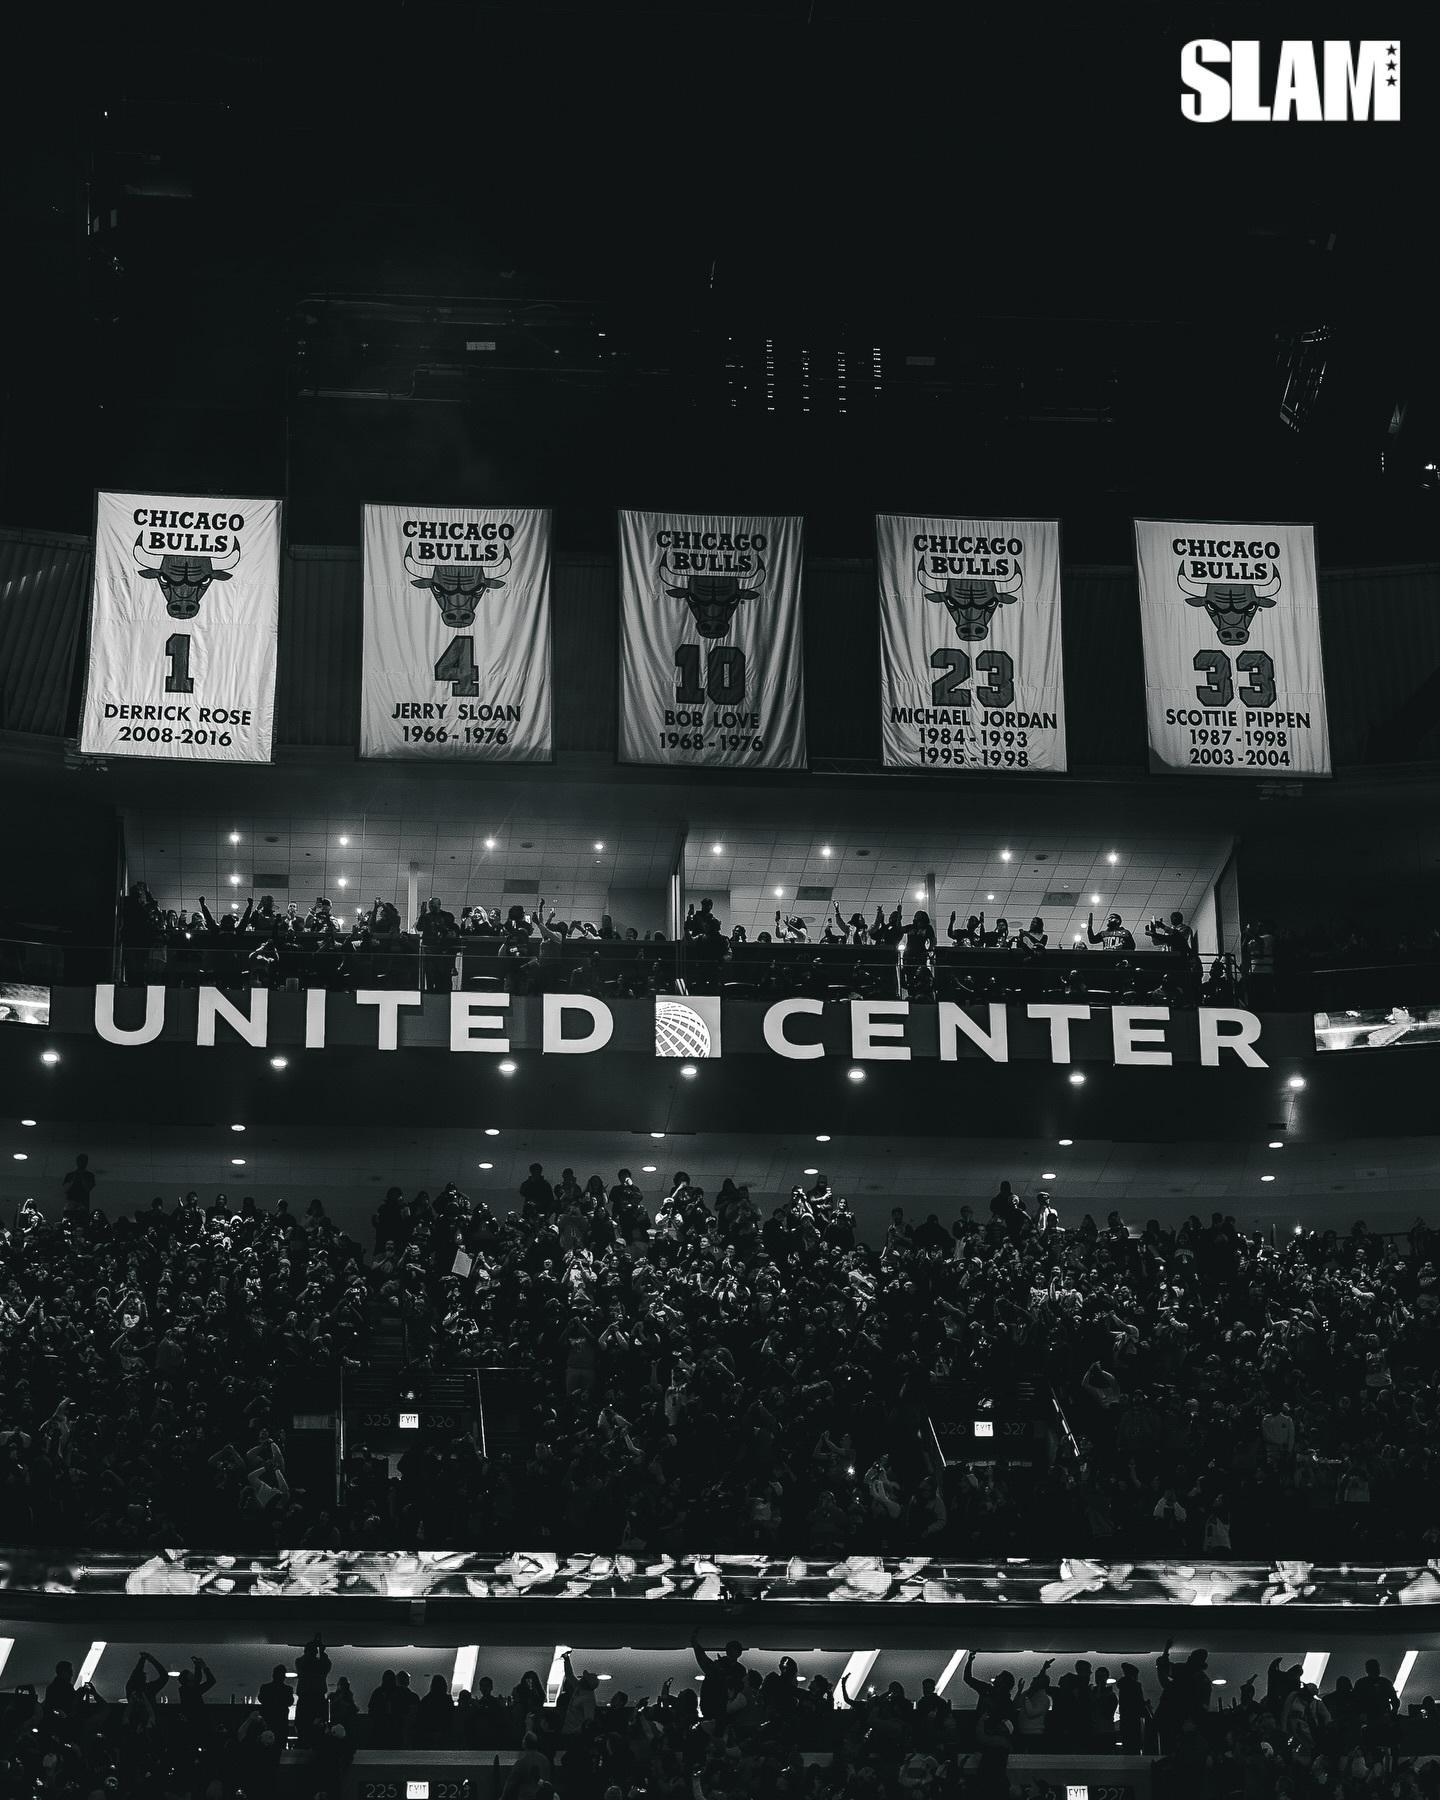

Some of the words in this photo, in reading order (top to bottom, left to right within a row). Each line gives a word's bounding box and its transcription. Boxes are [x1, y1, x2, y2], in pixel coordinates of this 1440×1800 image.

[133, 508, 244, 531] CHICAGO
[403, 521, 514, 540] CHICAGO
[149, 532, 228, 553] BULLS
[656, 531, 767, 551] CHICAGO
[914, 535, 1023, 555] CHICAGO
[1172, 539, 1280, 559] CHICAGO
[418, 542, 498, 561] BULLS
[672, 553, 752, 572] BULLS
[931, 556, 1009, 576] BULLS
[1191, 561, 1267, 580] BULLS
[165, 634, 194, 693] 1
[435, 635, 479, 696] 4
[675, 644, 745, 705] 10
[930, 648, 1014, 708] 23
[1193, 650, 1276, 708] 33
[104, 703, 190, 722] DERRICK
[199, 708, 251, 726] ROSE
[392, 703, 448, 720] JERRY
[458, 704, 521, 722] SLOAN
[665, 710, 703, 726] BOB
[713, 711, 760, 729] LOVE
[890, 708, 970, 726] MICHAEL
[981, 710, 1057, 729] JORDAN
[1167, 709, 1237, 727] SCOTTIE
[1246, 712, 1310, 729] PIPPEN
[119, 726, 232, 746] 2008-2016
[1190, 749, 1290, 767] 2003-2004
[94, 984, 614, 1054] UNITED
[762, 997, 1269, 1068] CENTER
[363, 1414, 391, 1427] 325
[426, 1415, 456, 1428] 326
[365, 1783, 397, 1798] 225
[1097, 1787, 1124, 1800] 227
